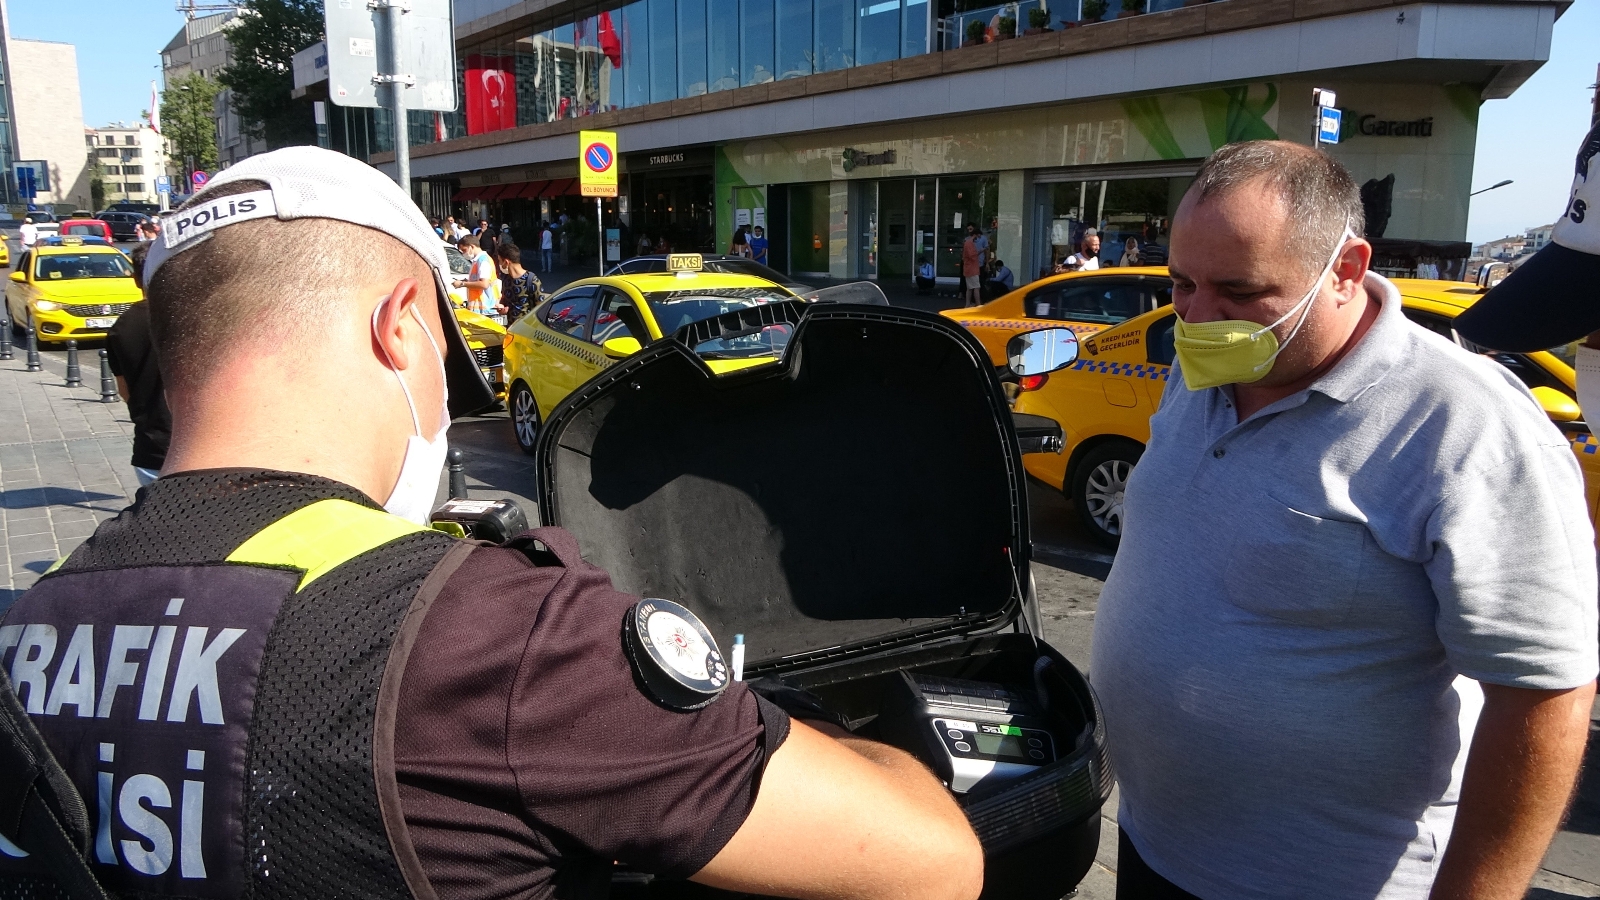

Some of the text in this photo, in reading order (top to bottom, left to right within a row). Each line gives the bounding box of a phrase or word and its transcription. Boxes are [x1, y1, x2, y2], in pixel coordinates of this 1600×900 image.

[1360, 114, 1434, 137] Garanti
[650, 153, 684, 164] STARBUCKS
[1121, 330, 1141, 339] KARTI
